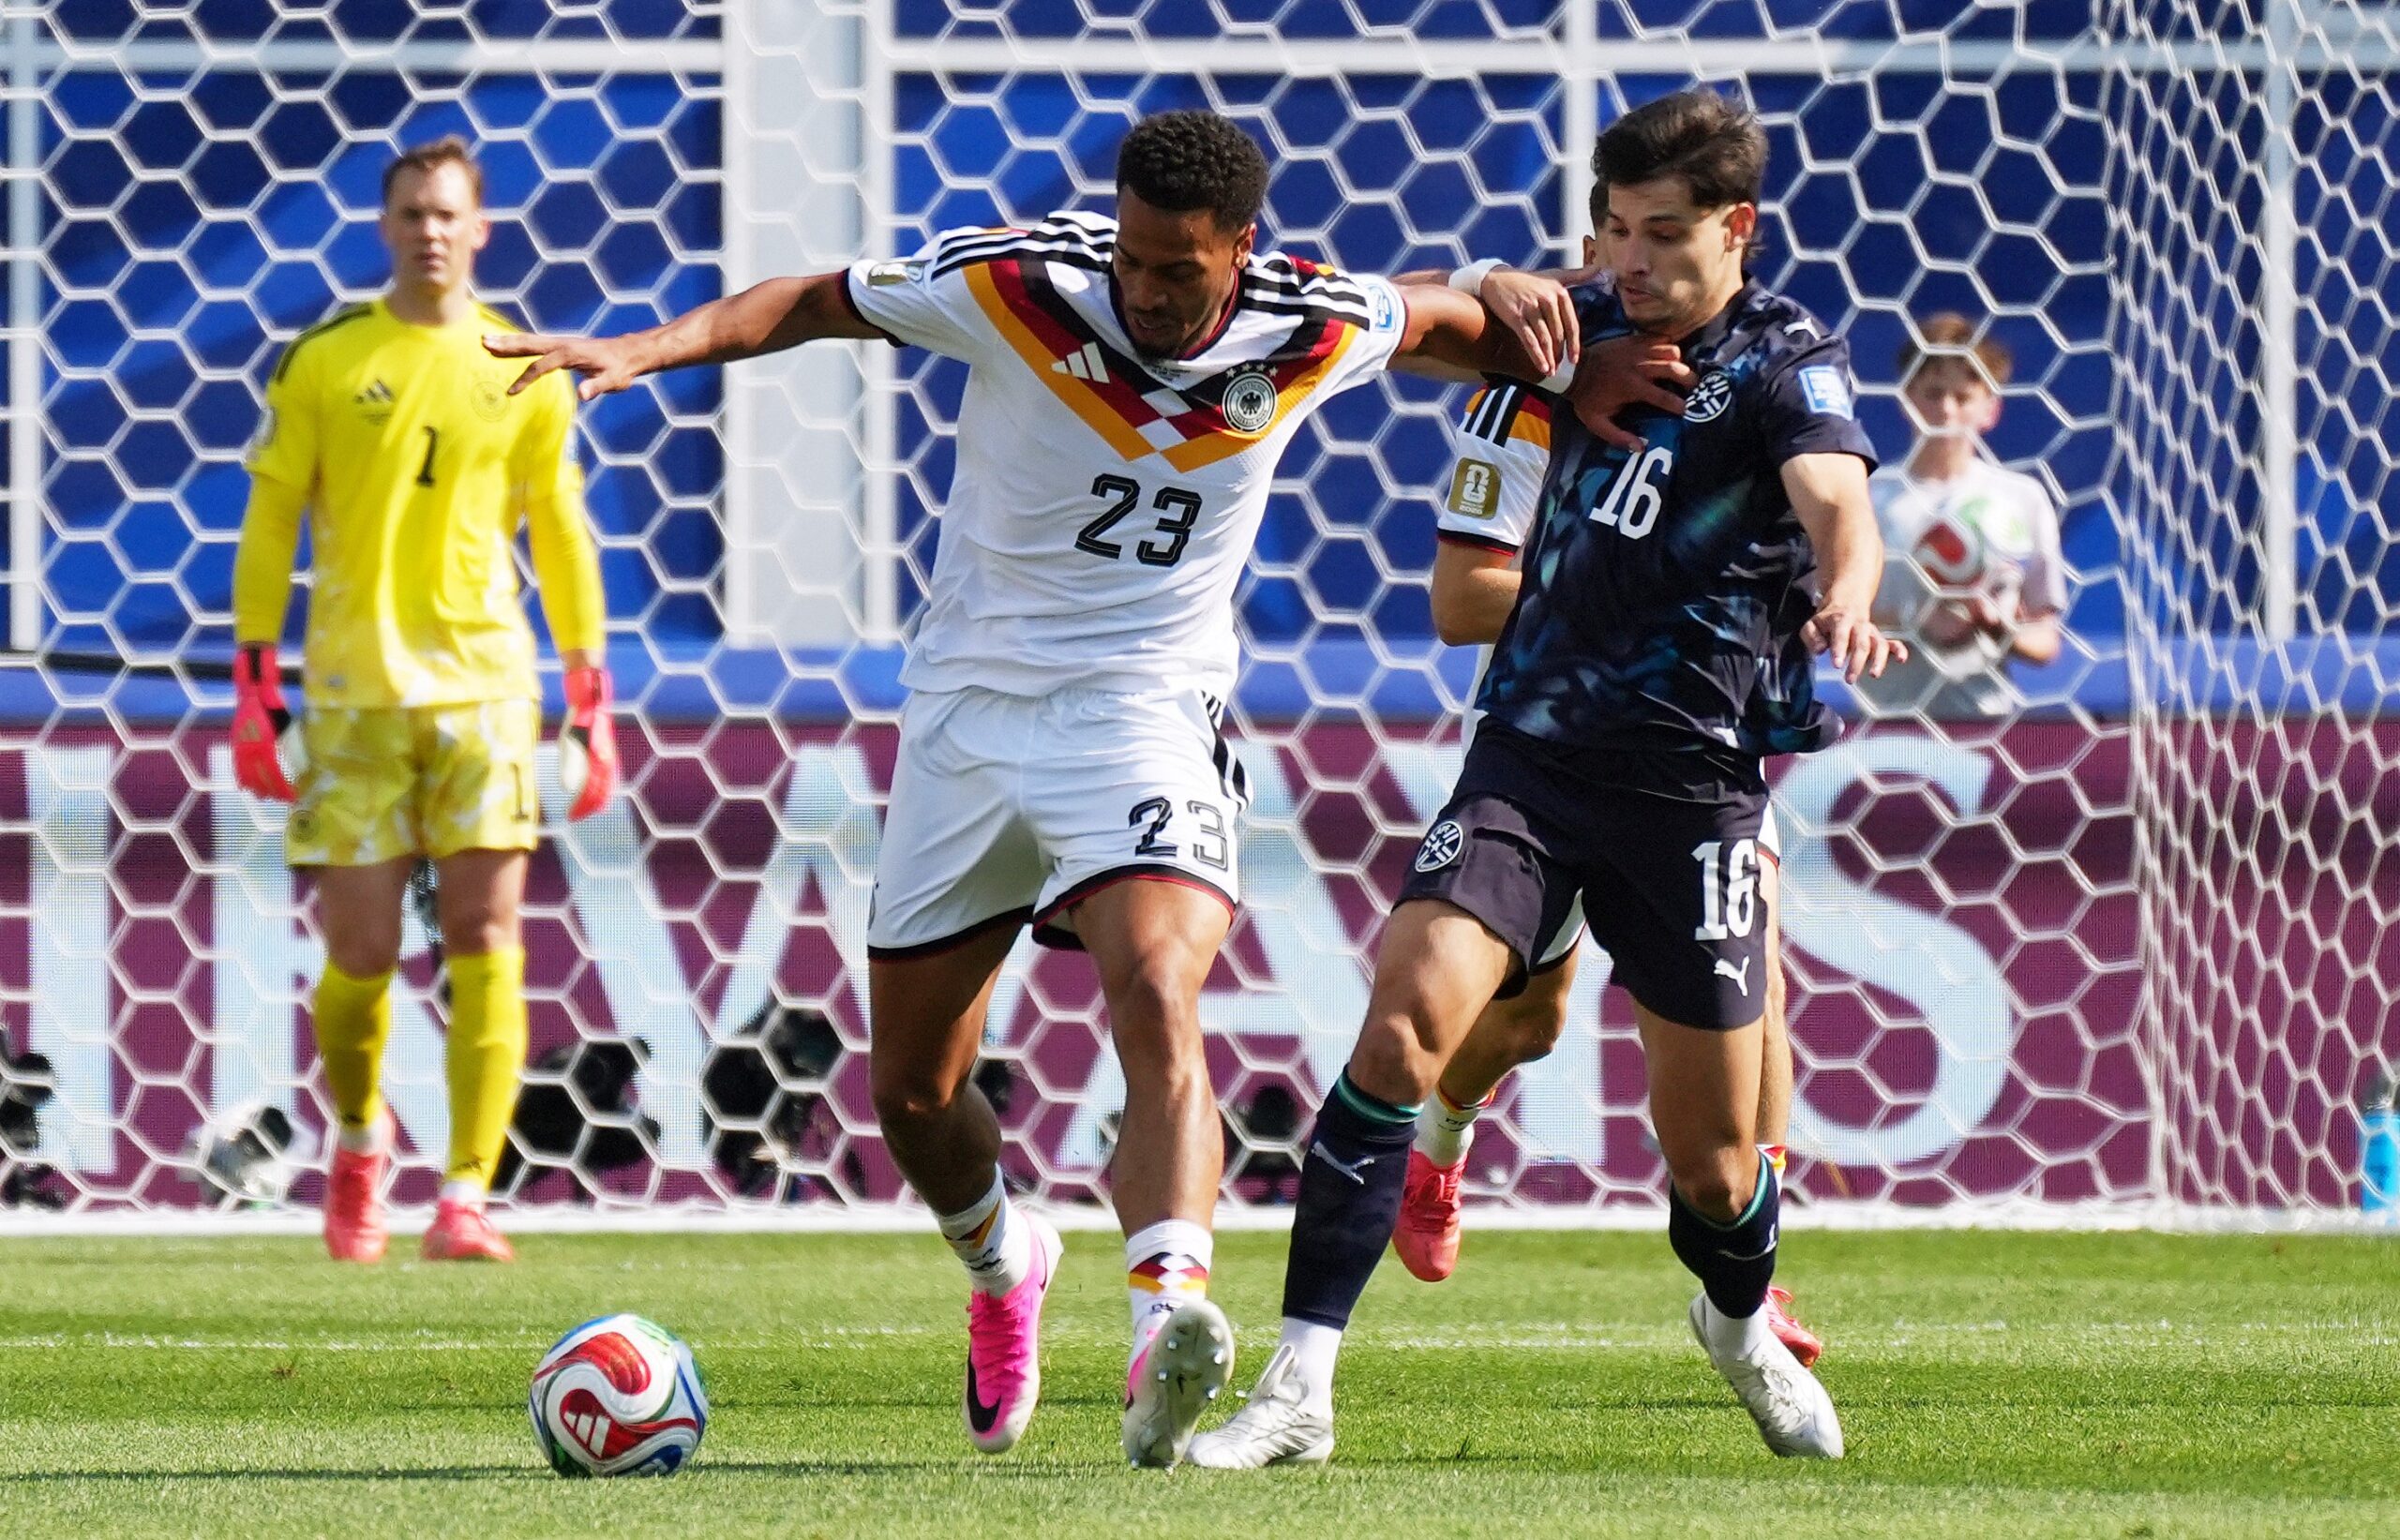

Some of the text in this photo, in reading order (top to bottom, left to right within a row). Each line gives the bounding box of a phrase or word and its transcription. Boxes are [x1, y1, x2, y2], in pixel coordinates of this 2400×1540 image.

[415, 425, 438, 487] 1
[1588, 445, 1672, 541] 16
[1073, 472, 1203, 568] 23
[509, 761, 530, 823] 1
[1128, 796, 1229, 873] 23
[1690, 838, 1757, 941] 16
